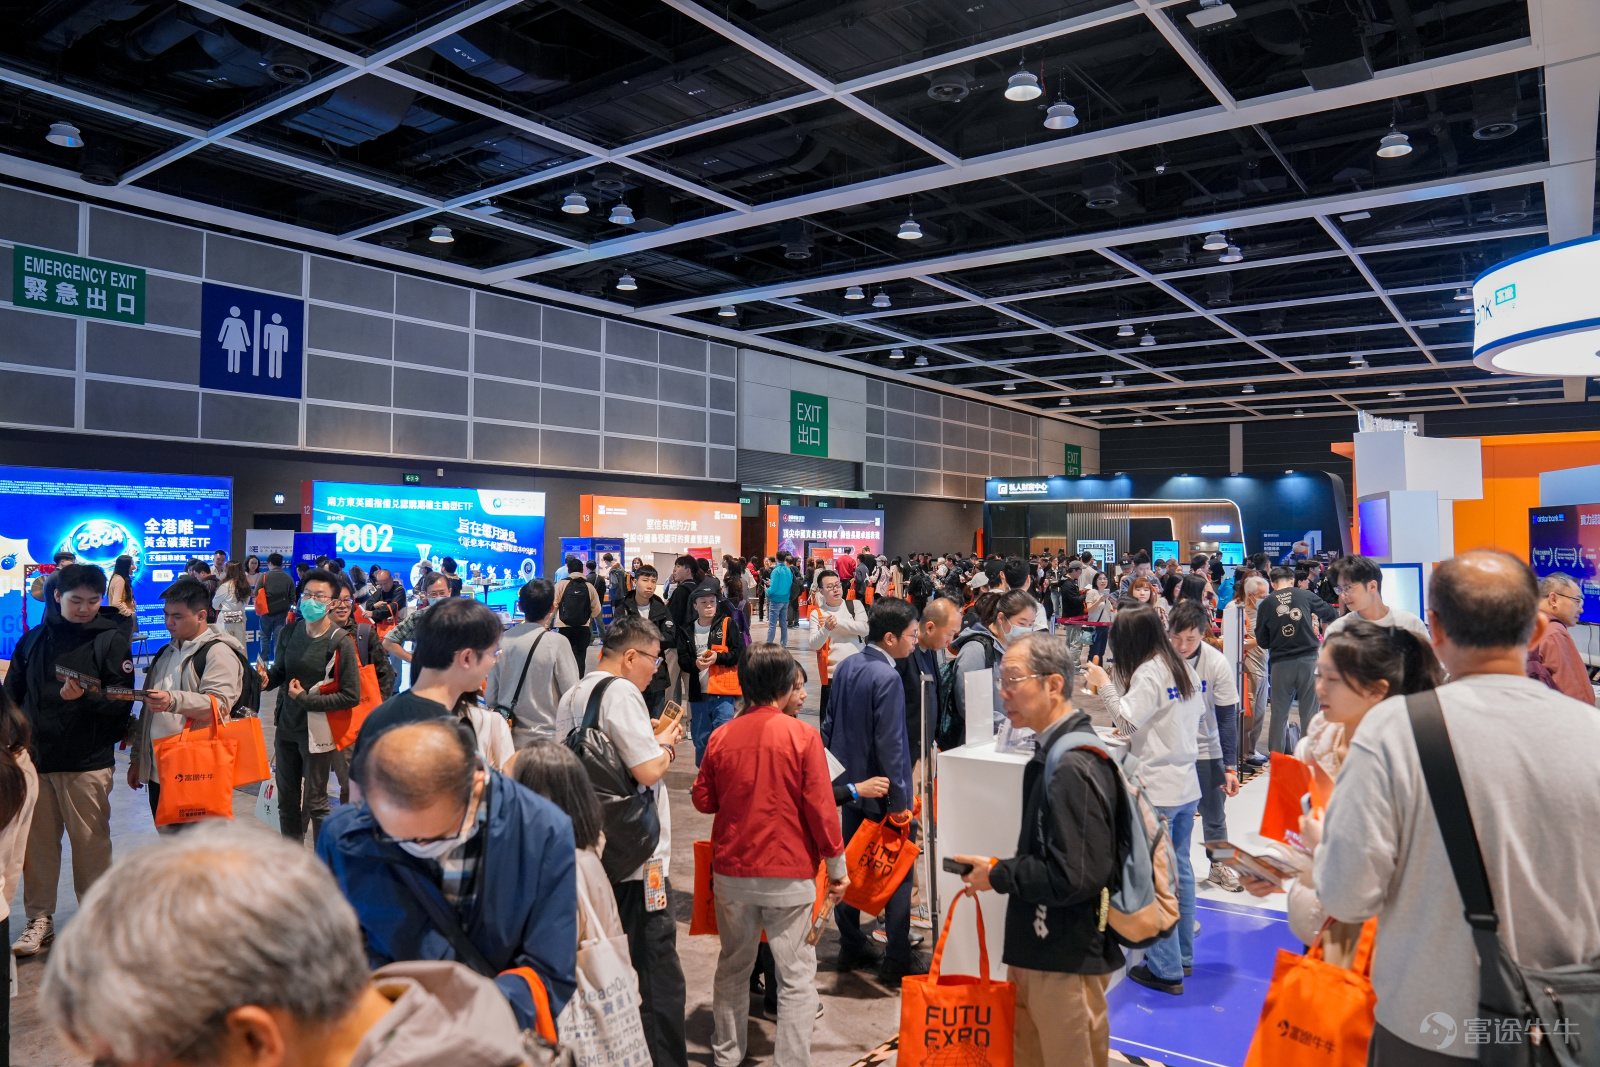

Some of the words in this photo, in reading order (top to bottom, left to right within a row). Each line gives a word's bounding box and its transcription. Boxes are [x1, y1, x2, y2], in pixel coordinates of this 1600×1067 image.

[24, 255, 107, 284] EMERGENCY
[110, 272, 137, 289] EXIT
[24, 275, 135, 315] 緊急出口
[797, 402, 822, 424] EXIT
[798, 425, 820, 446] 出口
[1068, 451, 1079, 464] EXIT
[303, 505, 311, 515] 12
[582, 514, 590, 522] 13
[144, 517, 210, 535] 全港唯一
[646, 519, 698, 532] 堅信長期的力量
[77, 527, 123, 551] 2824
[144, 536, 211, 548] 黃金礦業ETF
[328, 523, 393, 553] 2802
[865, 841, 899, 865] FUTU
[858, 854, 893, 877] EXPO
[925, 1005, 991, 1026] FUTU
[924, 1027, 990, 1049] EXPO
